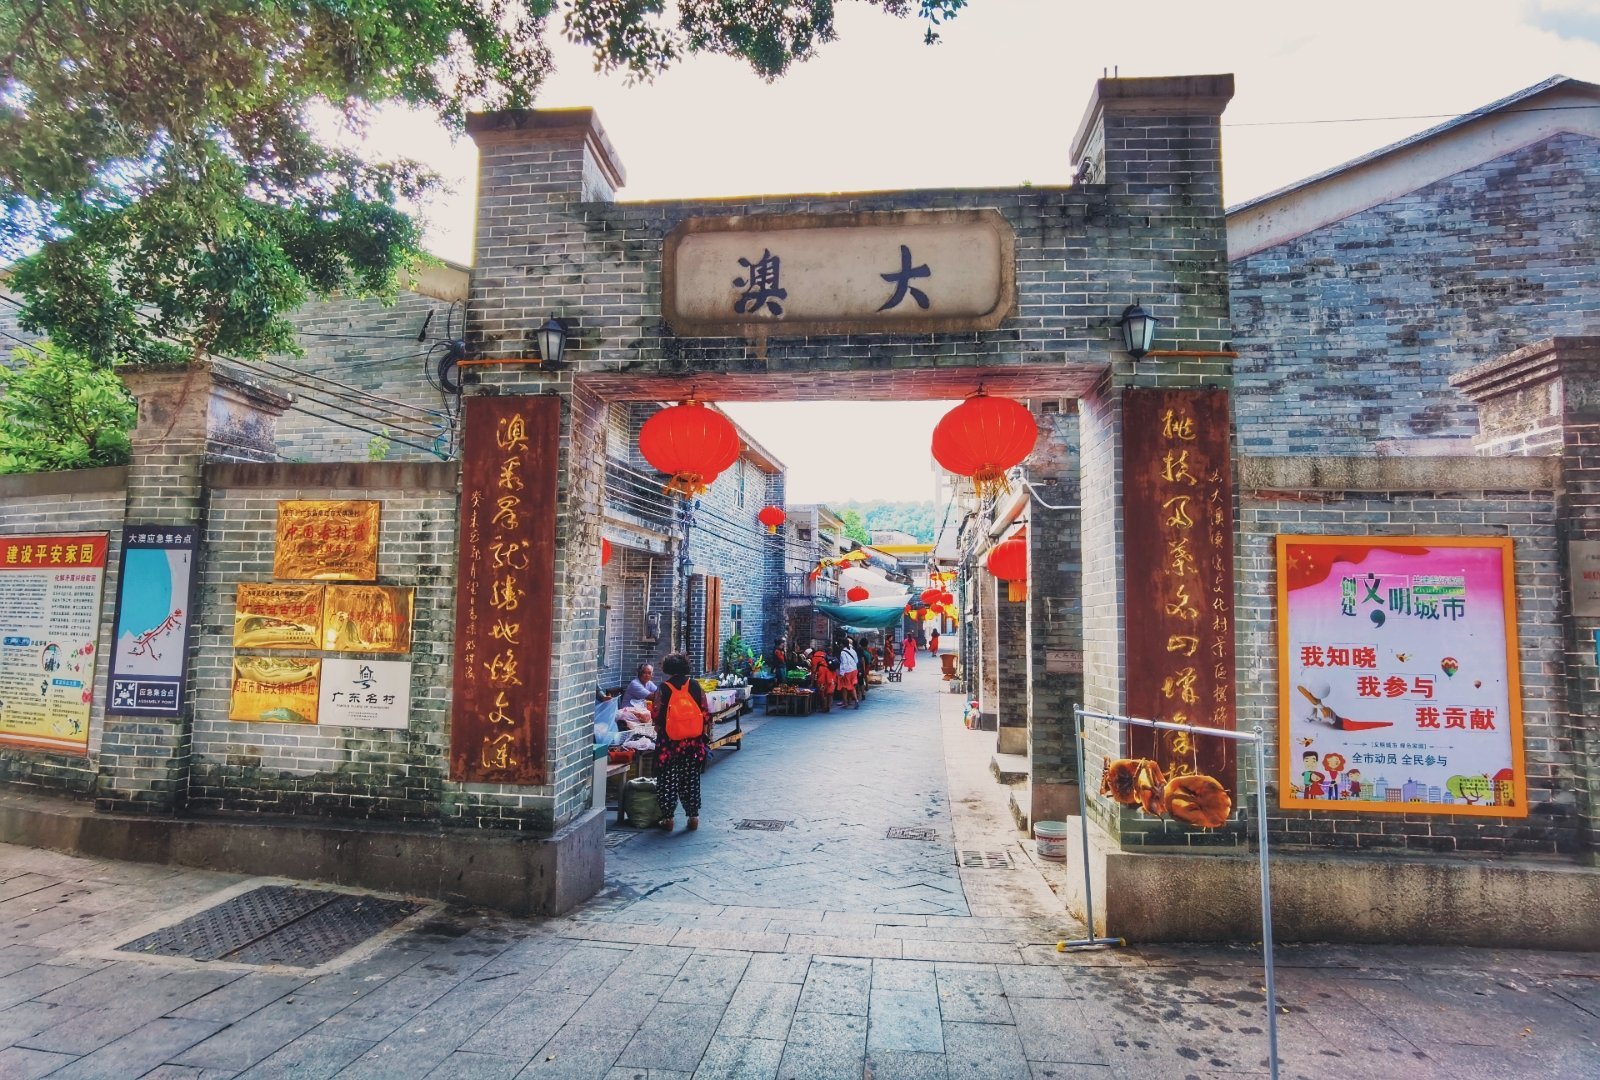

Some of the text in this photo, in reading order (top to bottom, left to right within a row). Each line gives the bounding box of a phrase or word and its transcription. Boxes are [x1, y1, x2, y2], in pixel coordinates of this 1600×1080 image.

[732, 244, 932, 316] 大澳
[128, 533, 192, 544] 大澳应急集合点
[6, 543, 94, 564] 建设平安家园
[1300, 645, 1377, 669] 我知晓
[139, 688, 174, 697] 应急集合点
[332, 691, 396, 705] 广东名村
[1356, 676, 1434, 699] 我参与
[1415, 706, 1496, 731] 我贡献
[1352, 752, 1447, 767] 全市动员 全民参与
